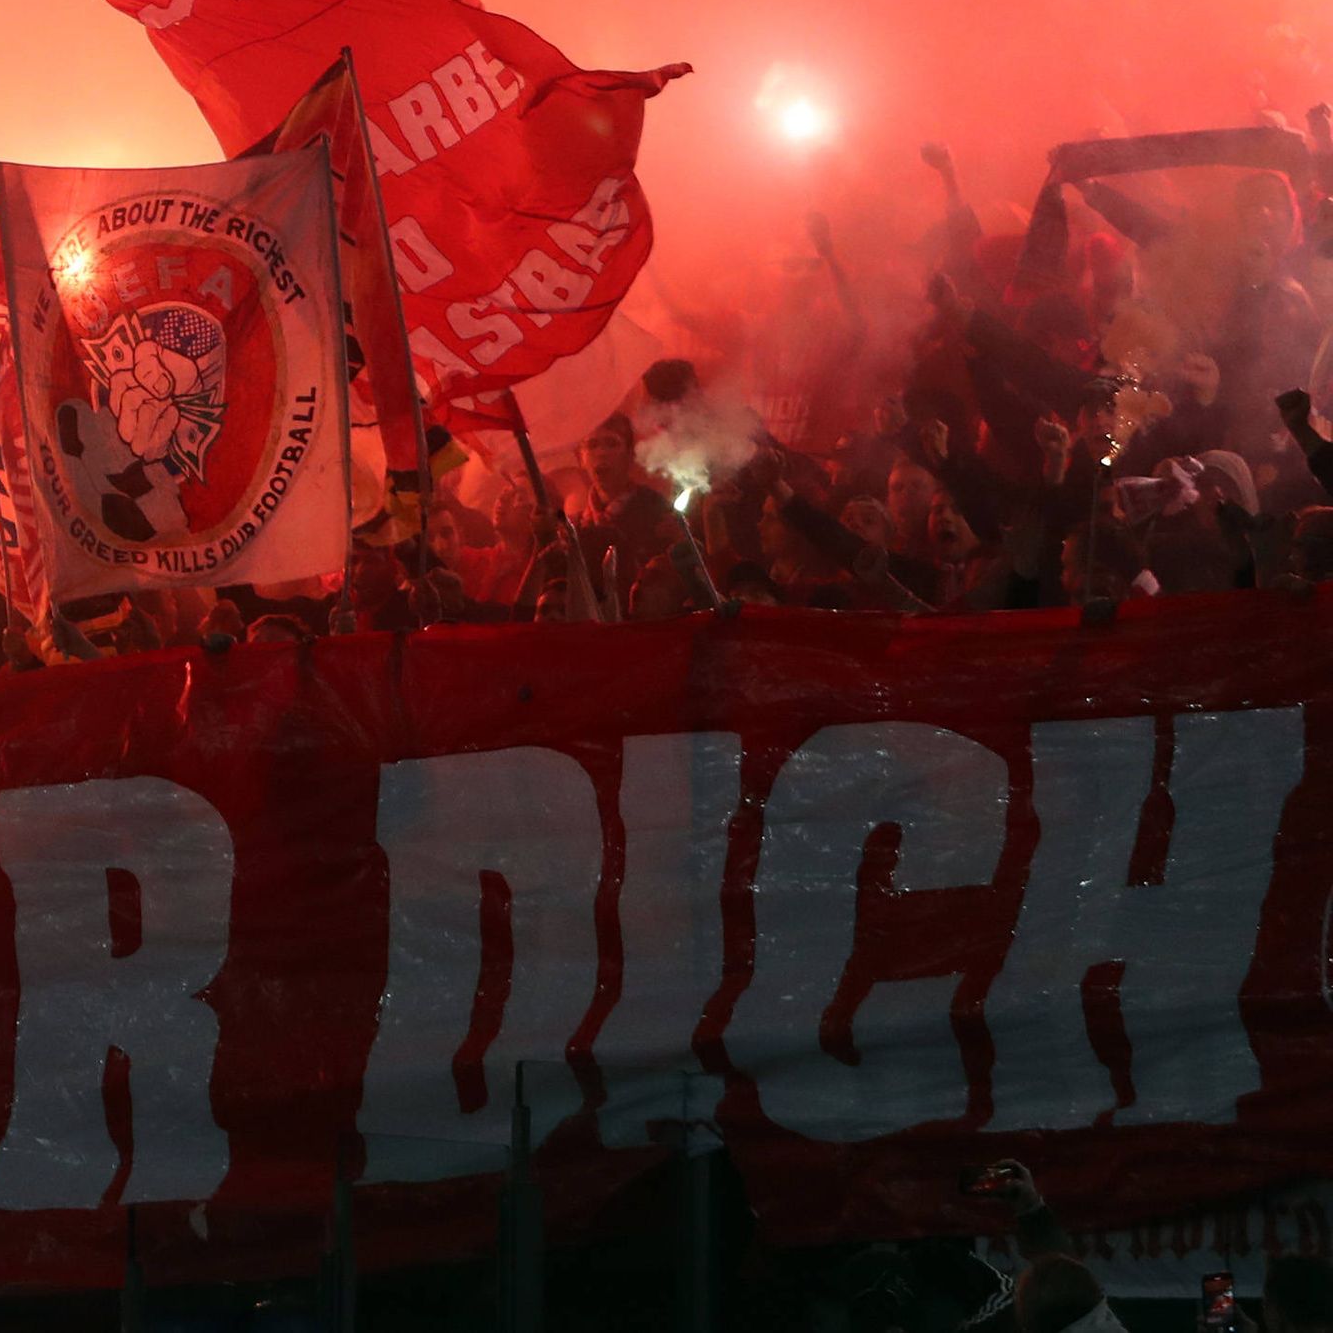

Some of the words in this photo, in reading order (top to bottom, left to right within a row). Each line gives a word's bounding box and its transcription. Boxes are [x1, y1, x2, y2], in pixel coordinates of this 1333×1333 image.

[369, 39, 526, 178] ARBE
[76, 254, 234, 335] UEFA
[96, 198, 175, 239] ABOUT
[180, 201, 222, 234] THE
[225, 216, 307, 306] RICHEST
[38, 435, 71, 517] YOUR
[69, 517, 149, 565] GREED
[155, 546, 218, 573] KILLS
[221, 525, 257, 561] OUR
[251, 386, 317, 527] FOOTBALL
[355, 706, 1305, 1184] DICH
